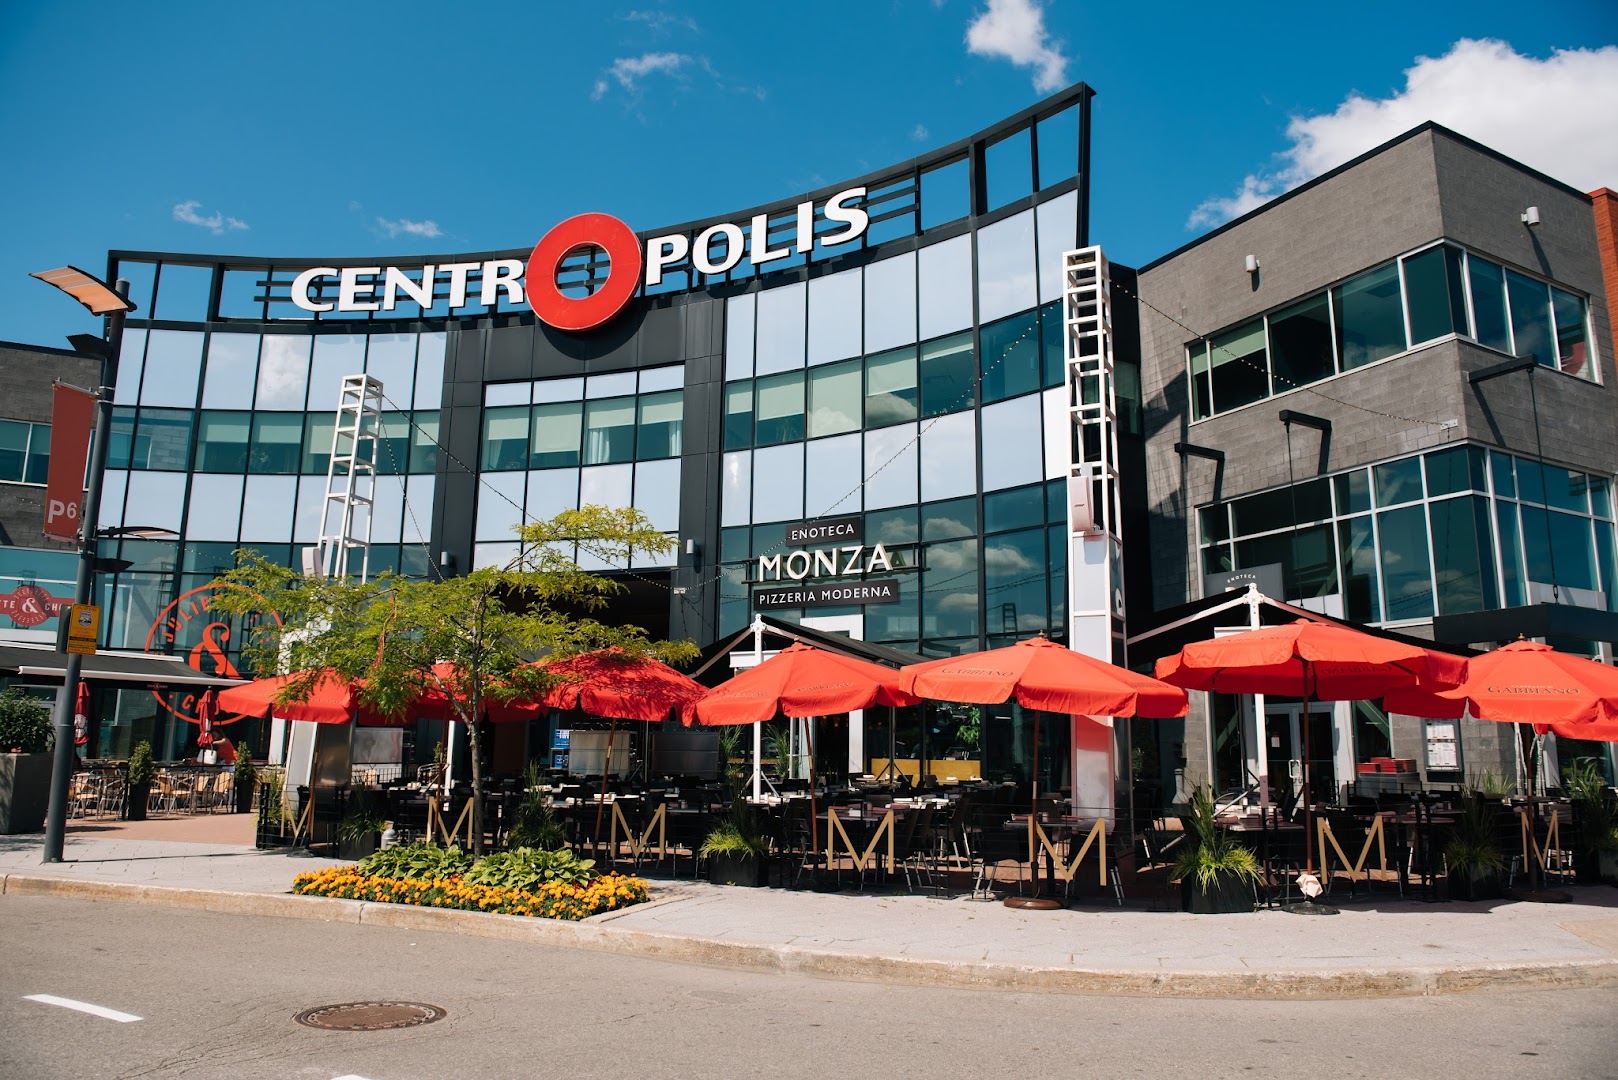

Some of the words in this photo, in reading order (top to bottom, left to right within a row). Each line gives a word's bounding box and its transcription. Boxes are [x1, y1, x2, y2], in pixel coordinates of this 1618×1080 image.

[791, 523, 855, 541] ENOTECA
[759, 543, 893, 582] MONZA
[1227, 574, 1256, 583] ENOTECA
[759, 591, 816, 605] PIZZERIA
[821, 586, 891, 600] MODERNA
[1487, 685, 1580, 696] GABBIANO
[827, 806, 895, 874] M
